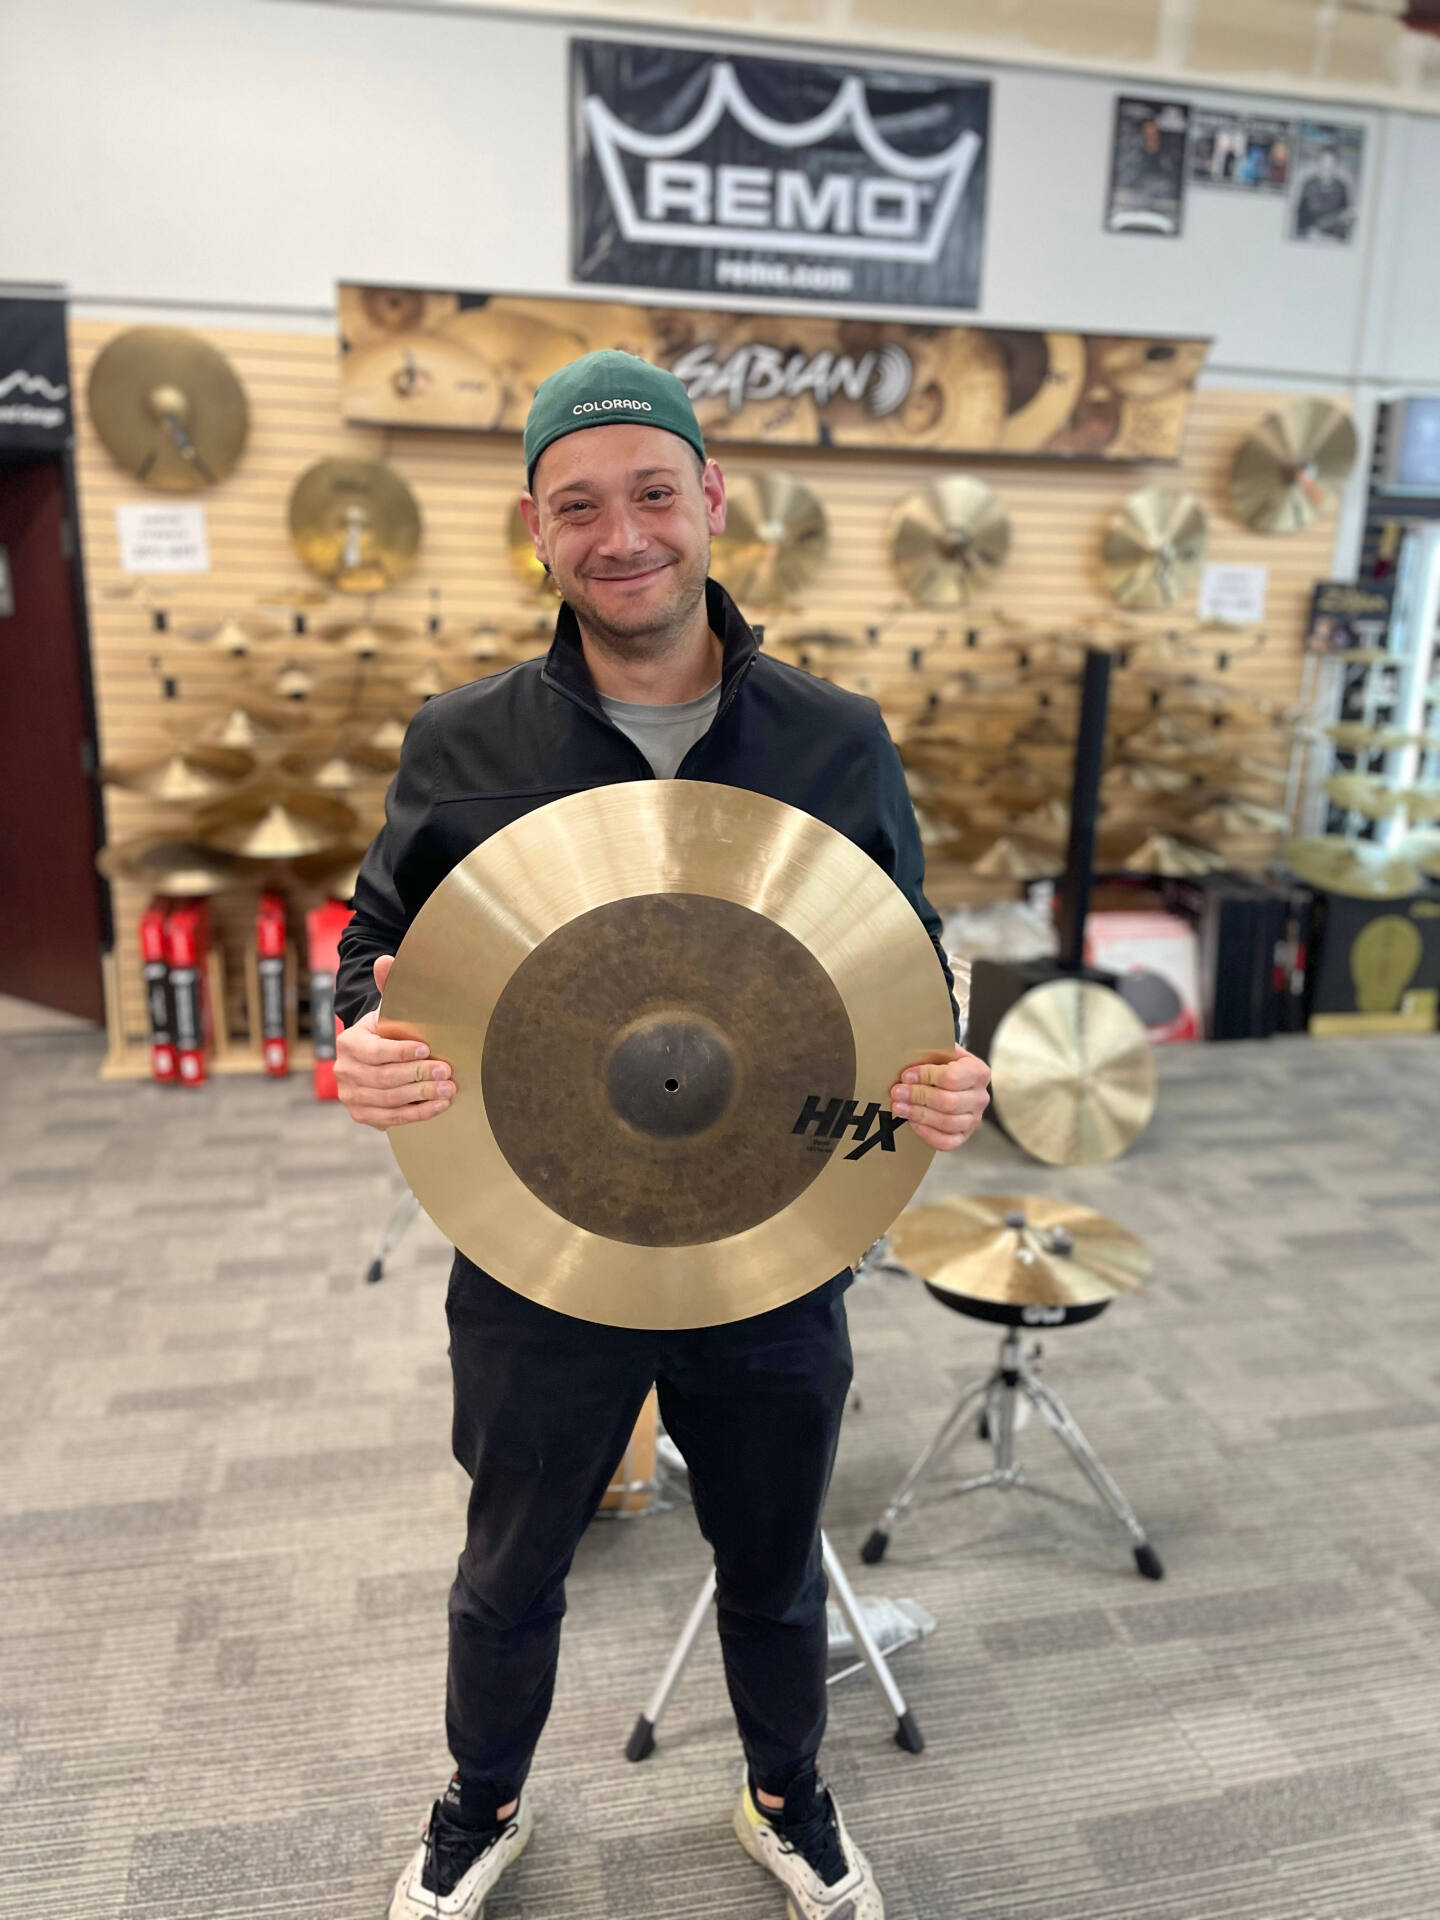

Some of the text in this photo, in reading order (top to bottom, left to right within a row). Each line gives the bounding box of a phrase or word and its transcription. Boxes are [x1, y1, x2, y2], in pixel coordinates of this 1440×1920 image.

[645, 159, 920, 238] REMO
[572, 399, 652, 415] COLORADO
[672, 342, 878, 413] SABIAN
[792, 1095, 908, 1161] HHX
